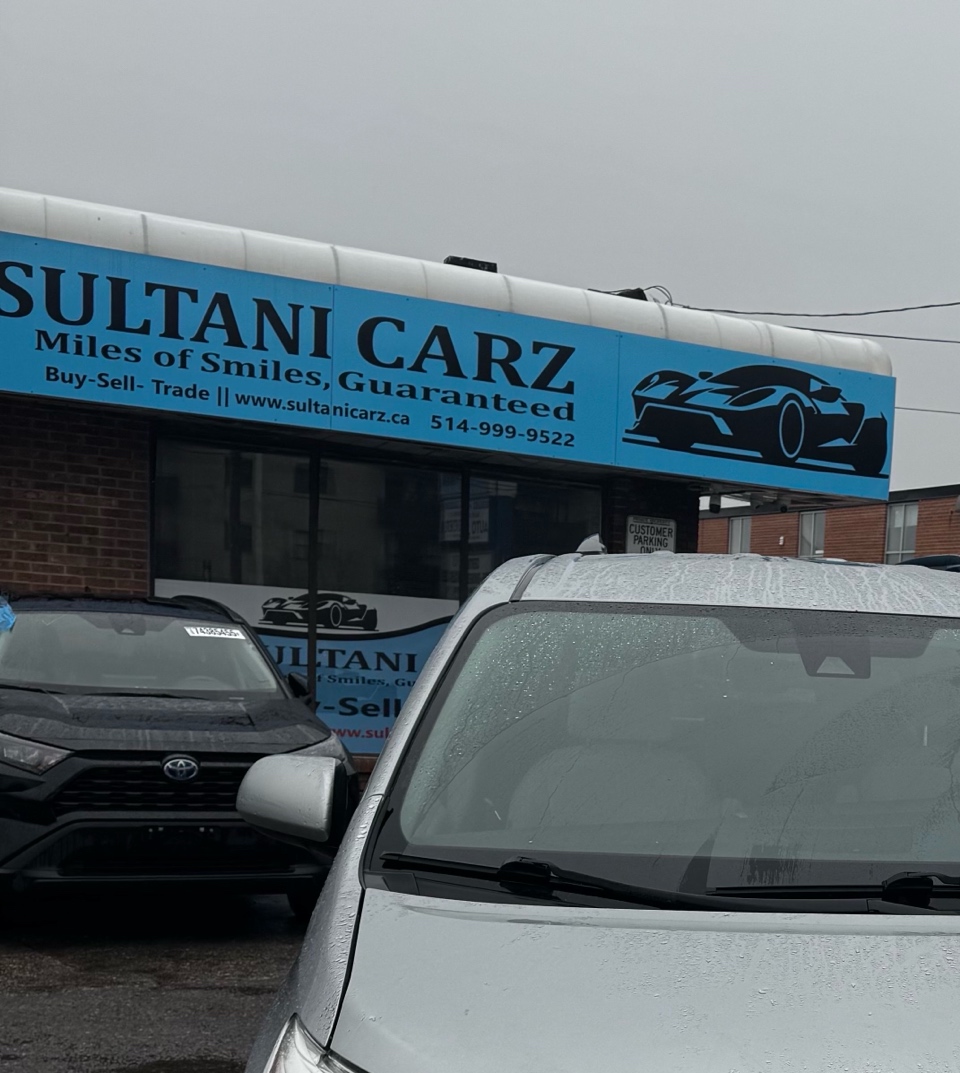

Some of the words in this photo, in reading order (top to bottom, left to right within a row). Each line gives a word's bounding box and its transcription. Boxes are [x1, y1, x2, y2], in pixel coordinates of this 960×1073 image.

[0, 261, 332, 359] SULTANI
[357, 316, 576, 395] CARZ
[35, 329, 142, 363] Miles
[154, 349, 194, 369] of
[201, 352, 330, 391] Smiles,
[338, 371, 576, 422] Guaranteed
[152, 379, 210, 401] Trade
[235, 393, 410, 425] www.sultanicarz.ca
[431, 414, 576, 447] 514-999-9522
[629, 523, 673, 538] CUSTOMER
[633, 535, 668, 548] PARKING
[263, 645, 417, 672] ULTANI
[327, 675, 389, 687] Smiles,
